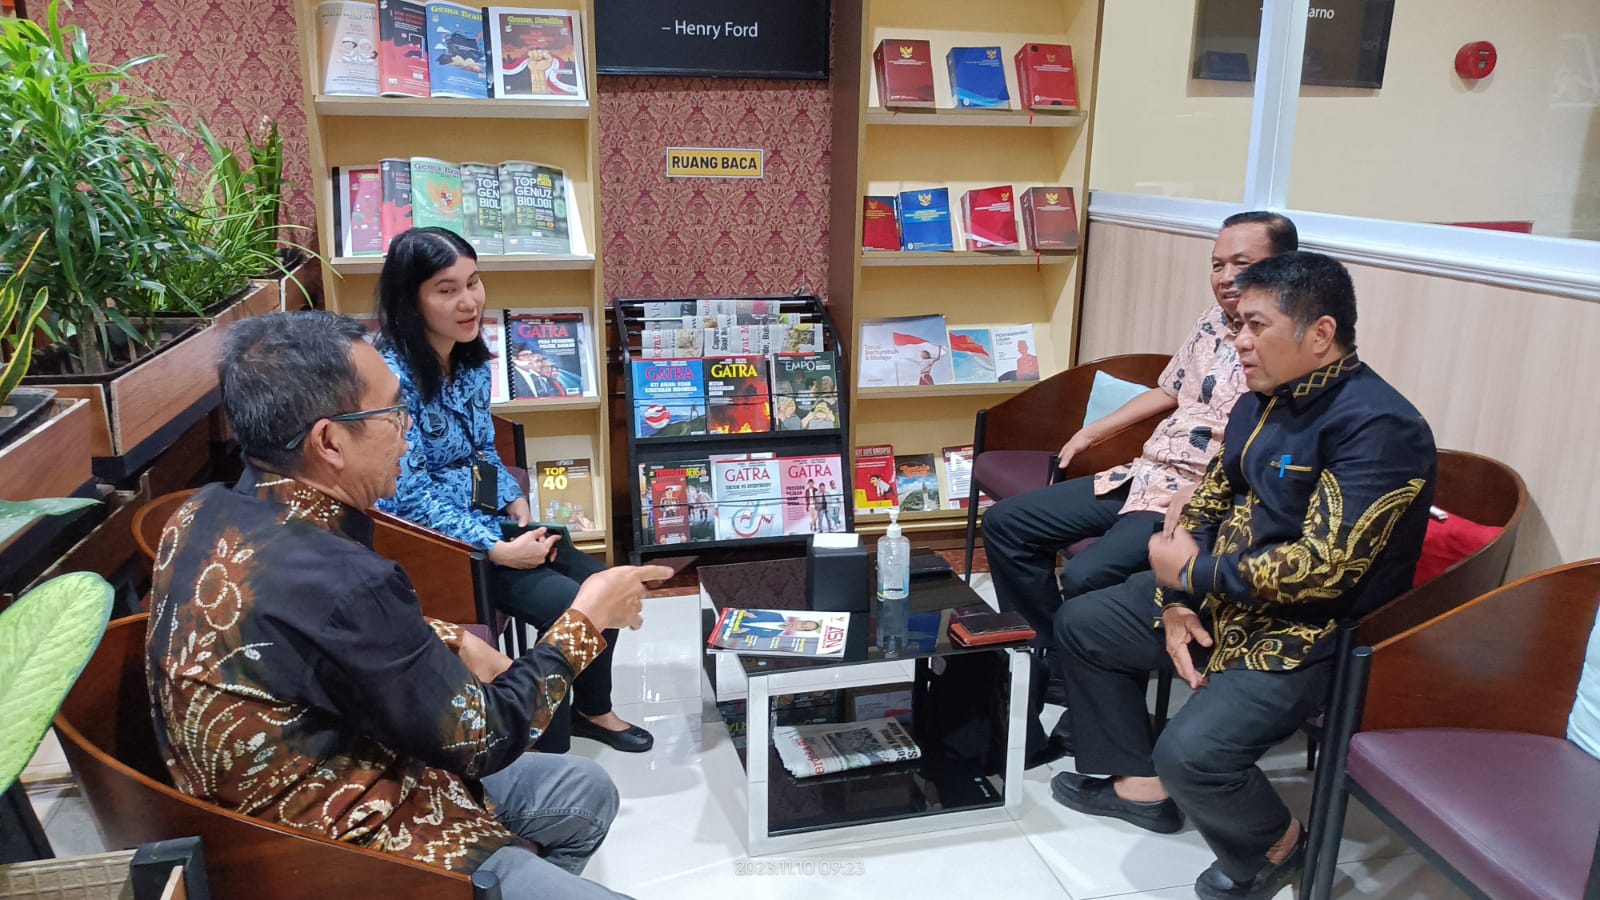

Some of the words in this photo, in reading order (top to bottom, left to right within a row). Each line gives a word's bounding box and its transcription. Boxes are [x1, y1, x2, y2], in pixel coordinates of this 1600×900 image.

[675, 20, 721, 40] Henry
[725, 21, 759, 38] Ford
[672, 156, 718, 169] RUANG
[721, 157, 758, 170] BACA
[476, 178, 499, 188] TOP
[513, 176, 537, 187] TOP
[514, 187, 552, 199] GENIUZ
[517, 196, 552, 209] BIOLOGI
[518, 323, 569, 338] GATRA
[645, 366, 695, 381] GATRA
[710, 364, 758, 379] GATRA
[543, 466, 566, 476] TOP
[724, 467, 771, 482] GATRA
[787, 464, 833, 479] GATRA
[542, 475, 568, 490] 40
[828, 626, 844, 649] ASN
